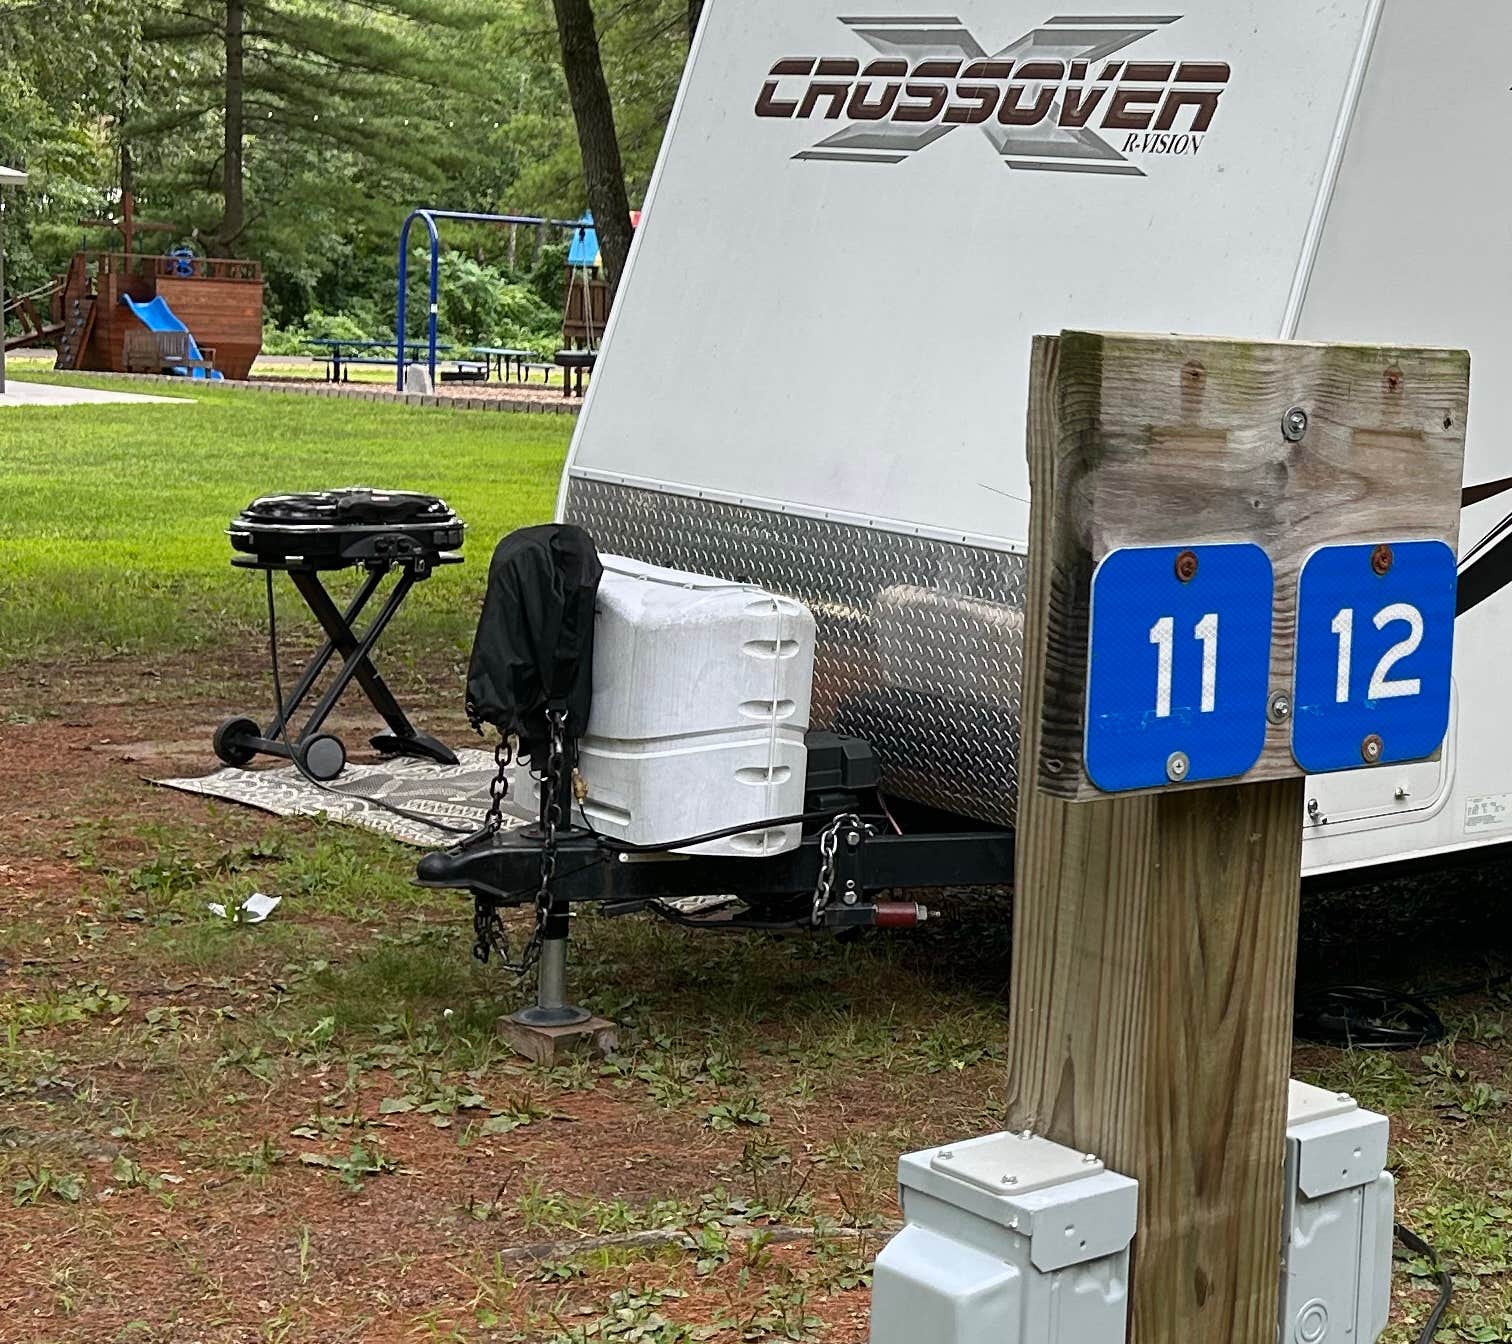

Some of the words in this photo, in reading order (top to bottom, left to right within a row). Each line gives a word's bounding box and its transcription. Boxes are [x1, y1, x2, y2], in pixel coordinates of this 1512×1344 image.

[755, 56, 1232, 131] CROSSOVER
[1122, 132, 1206, 156] R-VISION
[1149, 613, 1219, 718] 11
[1330, 602, 1425, 703] 12
